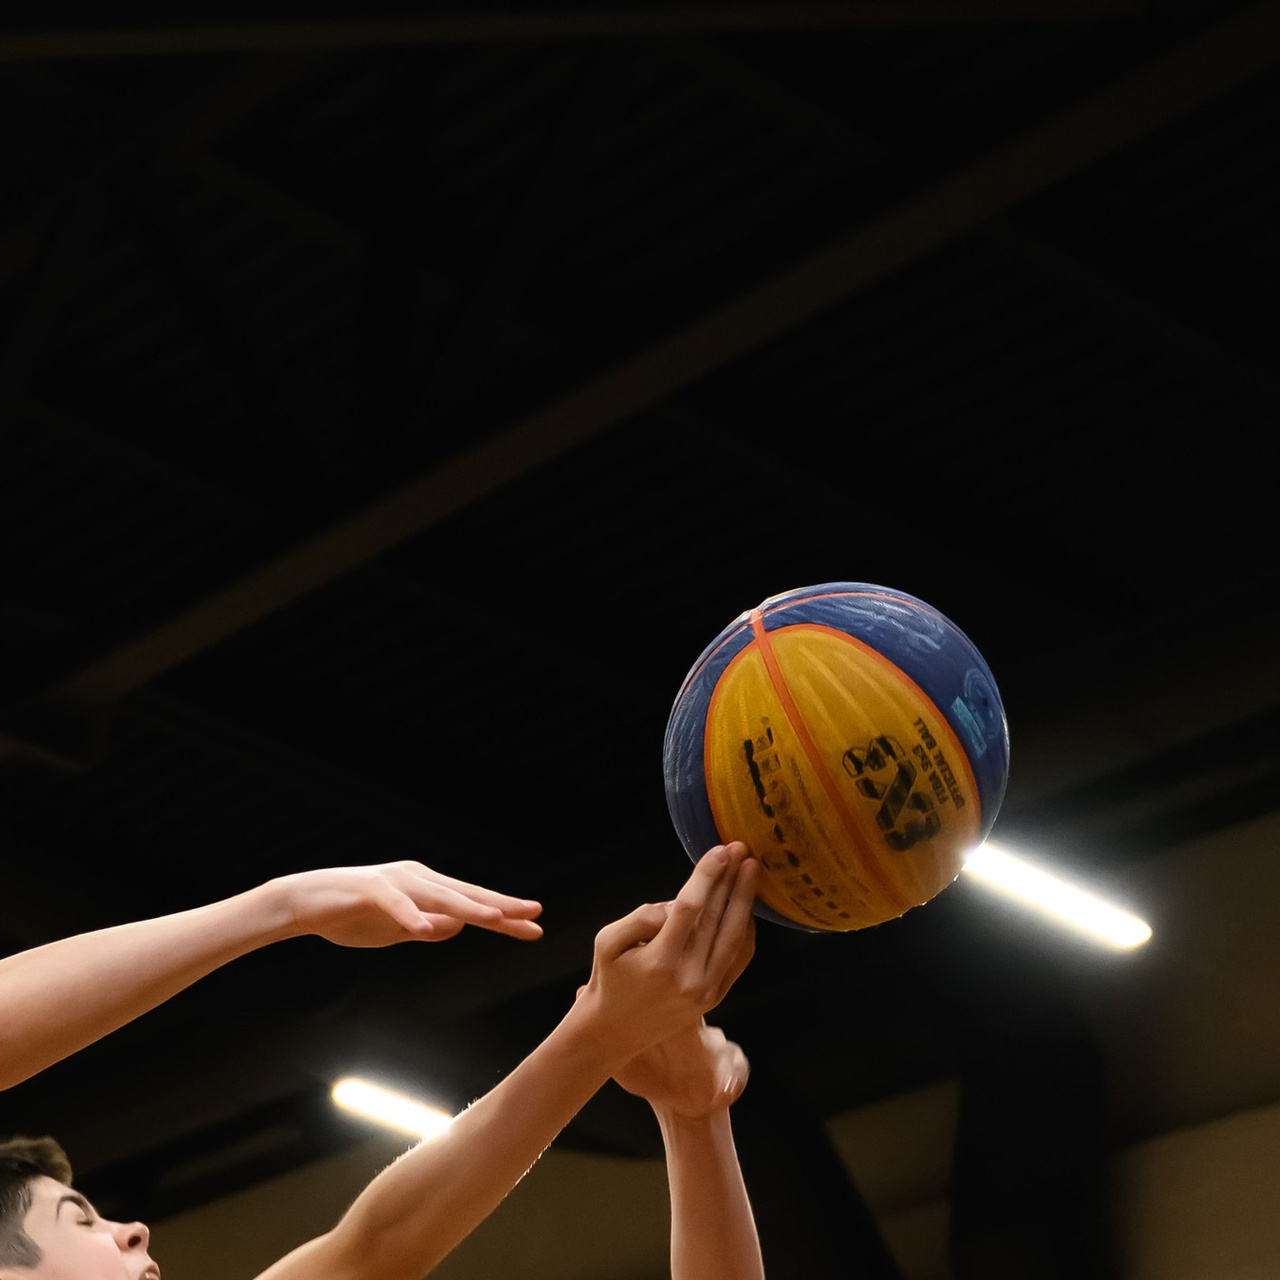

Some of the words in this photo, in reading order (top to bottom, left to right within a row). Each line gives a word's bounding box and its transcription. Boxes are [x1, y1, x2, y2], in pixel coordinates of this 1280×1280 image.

[914, 717, 937, 751] BALL
[928, 769, 949, 804] FIBA
[933, 749, 965, 811] OFFICIAL
